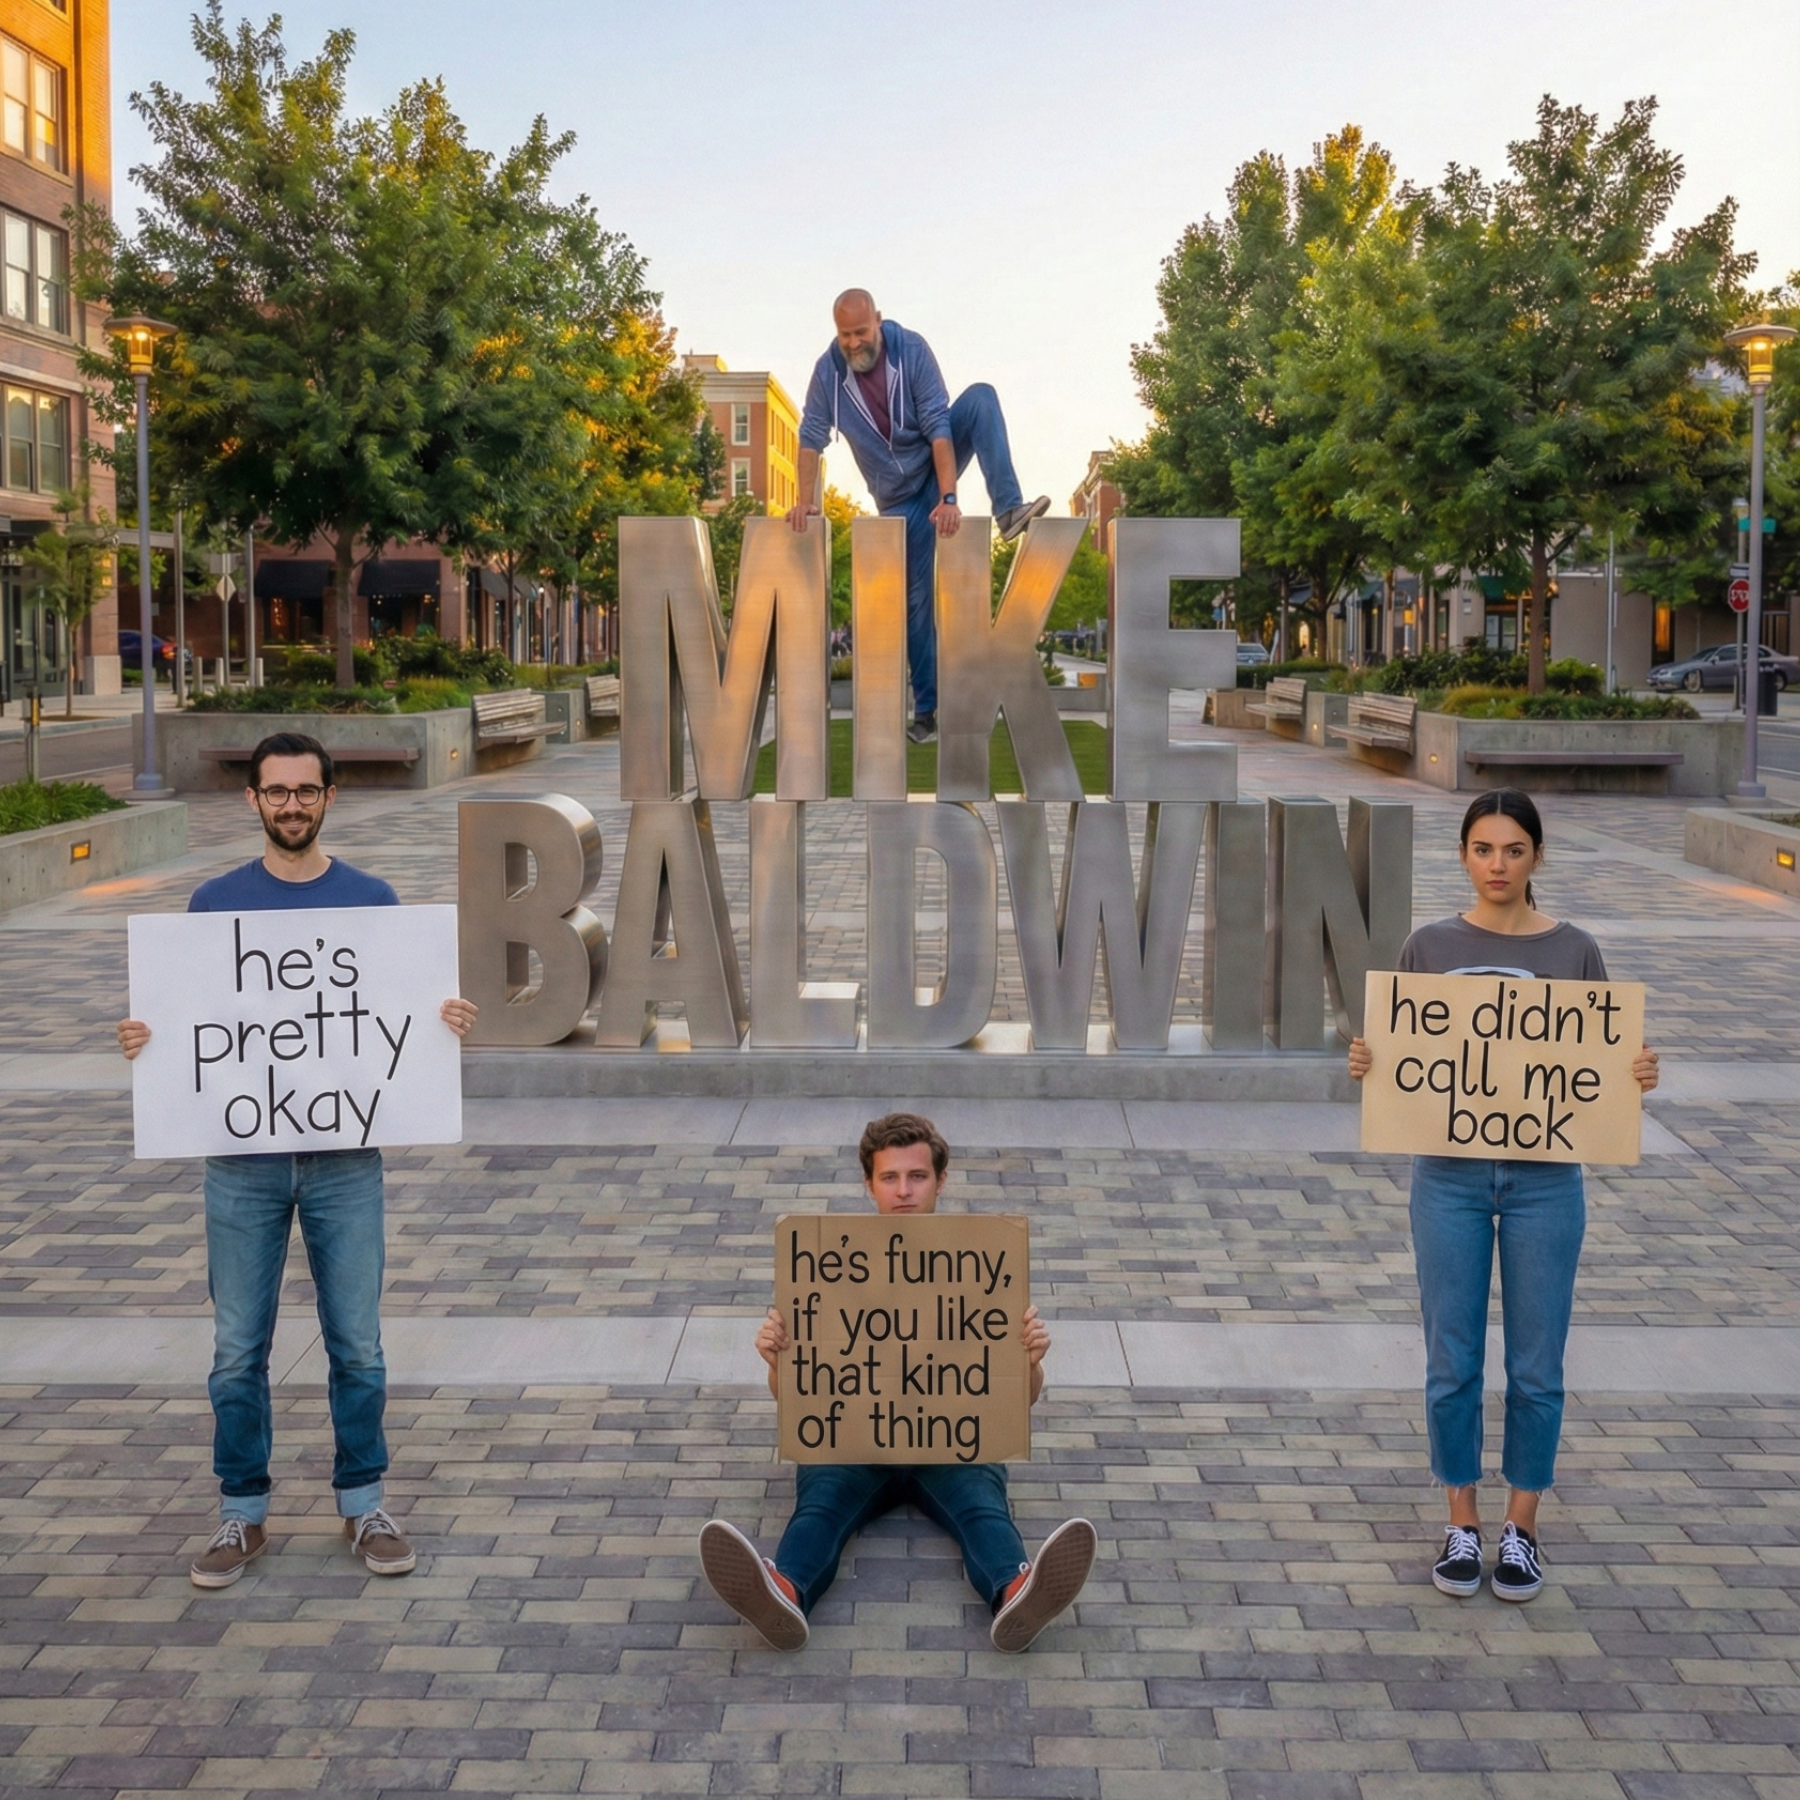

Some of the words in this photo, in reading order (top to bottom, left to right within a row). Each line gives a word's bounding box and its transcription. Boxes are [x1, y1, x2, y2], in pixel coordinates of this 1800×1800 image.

[618, 516, 1242, 802] MIKE
[234, 917, 360, 993] he's
[458, 793, 1413, 1050] BALDWIN
[193, 990, 412, 1093] pretty
[1390, 975, 1451, 1036] he
[1471, 981, 1622, 1046] didn't
[1395, 1038, 1498, 1097] call
[1523, 1062, 1601, 1103] me
[224, 1064, 381, 1147] okay
[1447, 1094, 1575, 1152] back
[791, 1230, 871, 1284] he's
[884, 1233, 1012, 1295] funny,
[792, 1291, 821, 1342] if
[839, 1308, 919, 1356] you
[937, 1294, 1009, 1341] like
[791, 1344, 882, 1396] that
[901, 1343, 990, 1396] kind
[797, 1400, 845, 1449] of
[868, 1400, 981, 1463] thing
